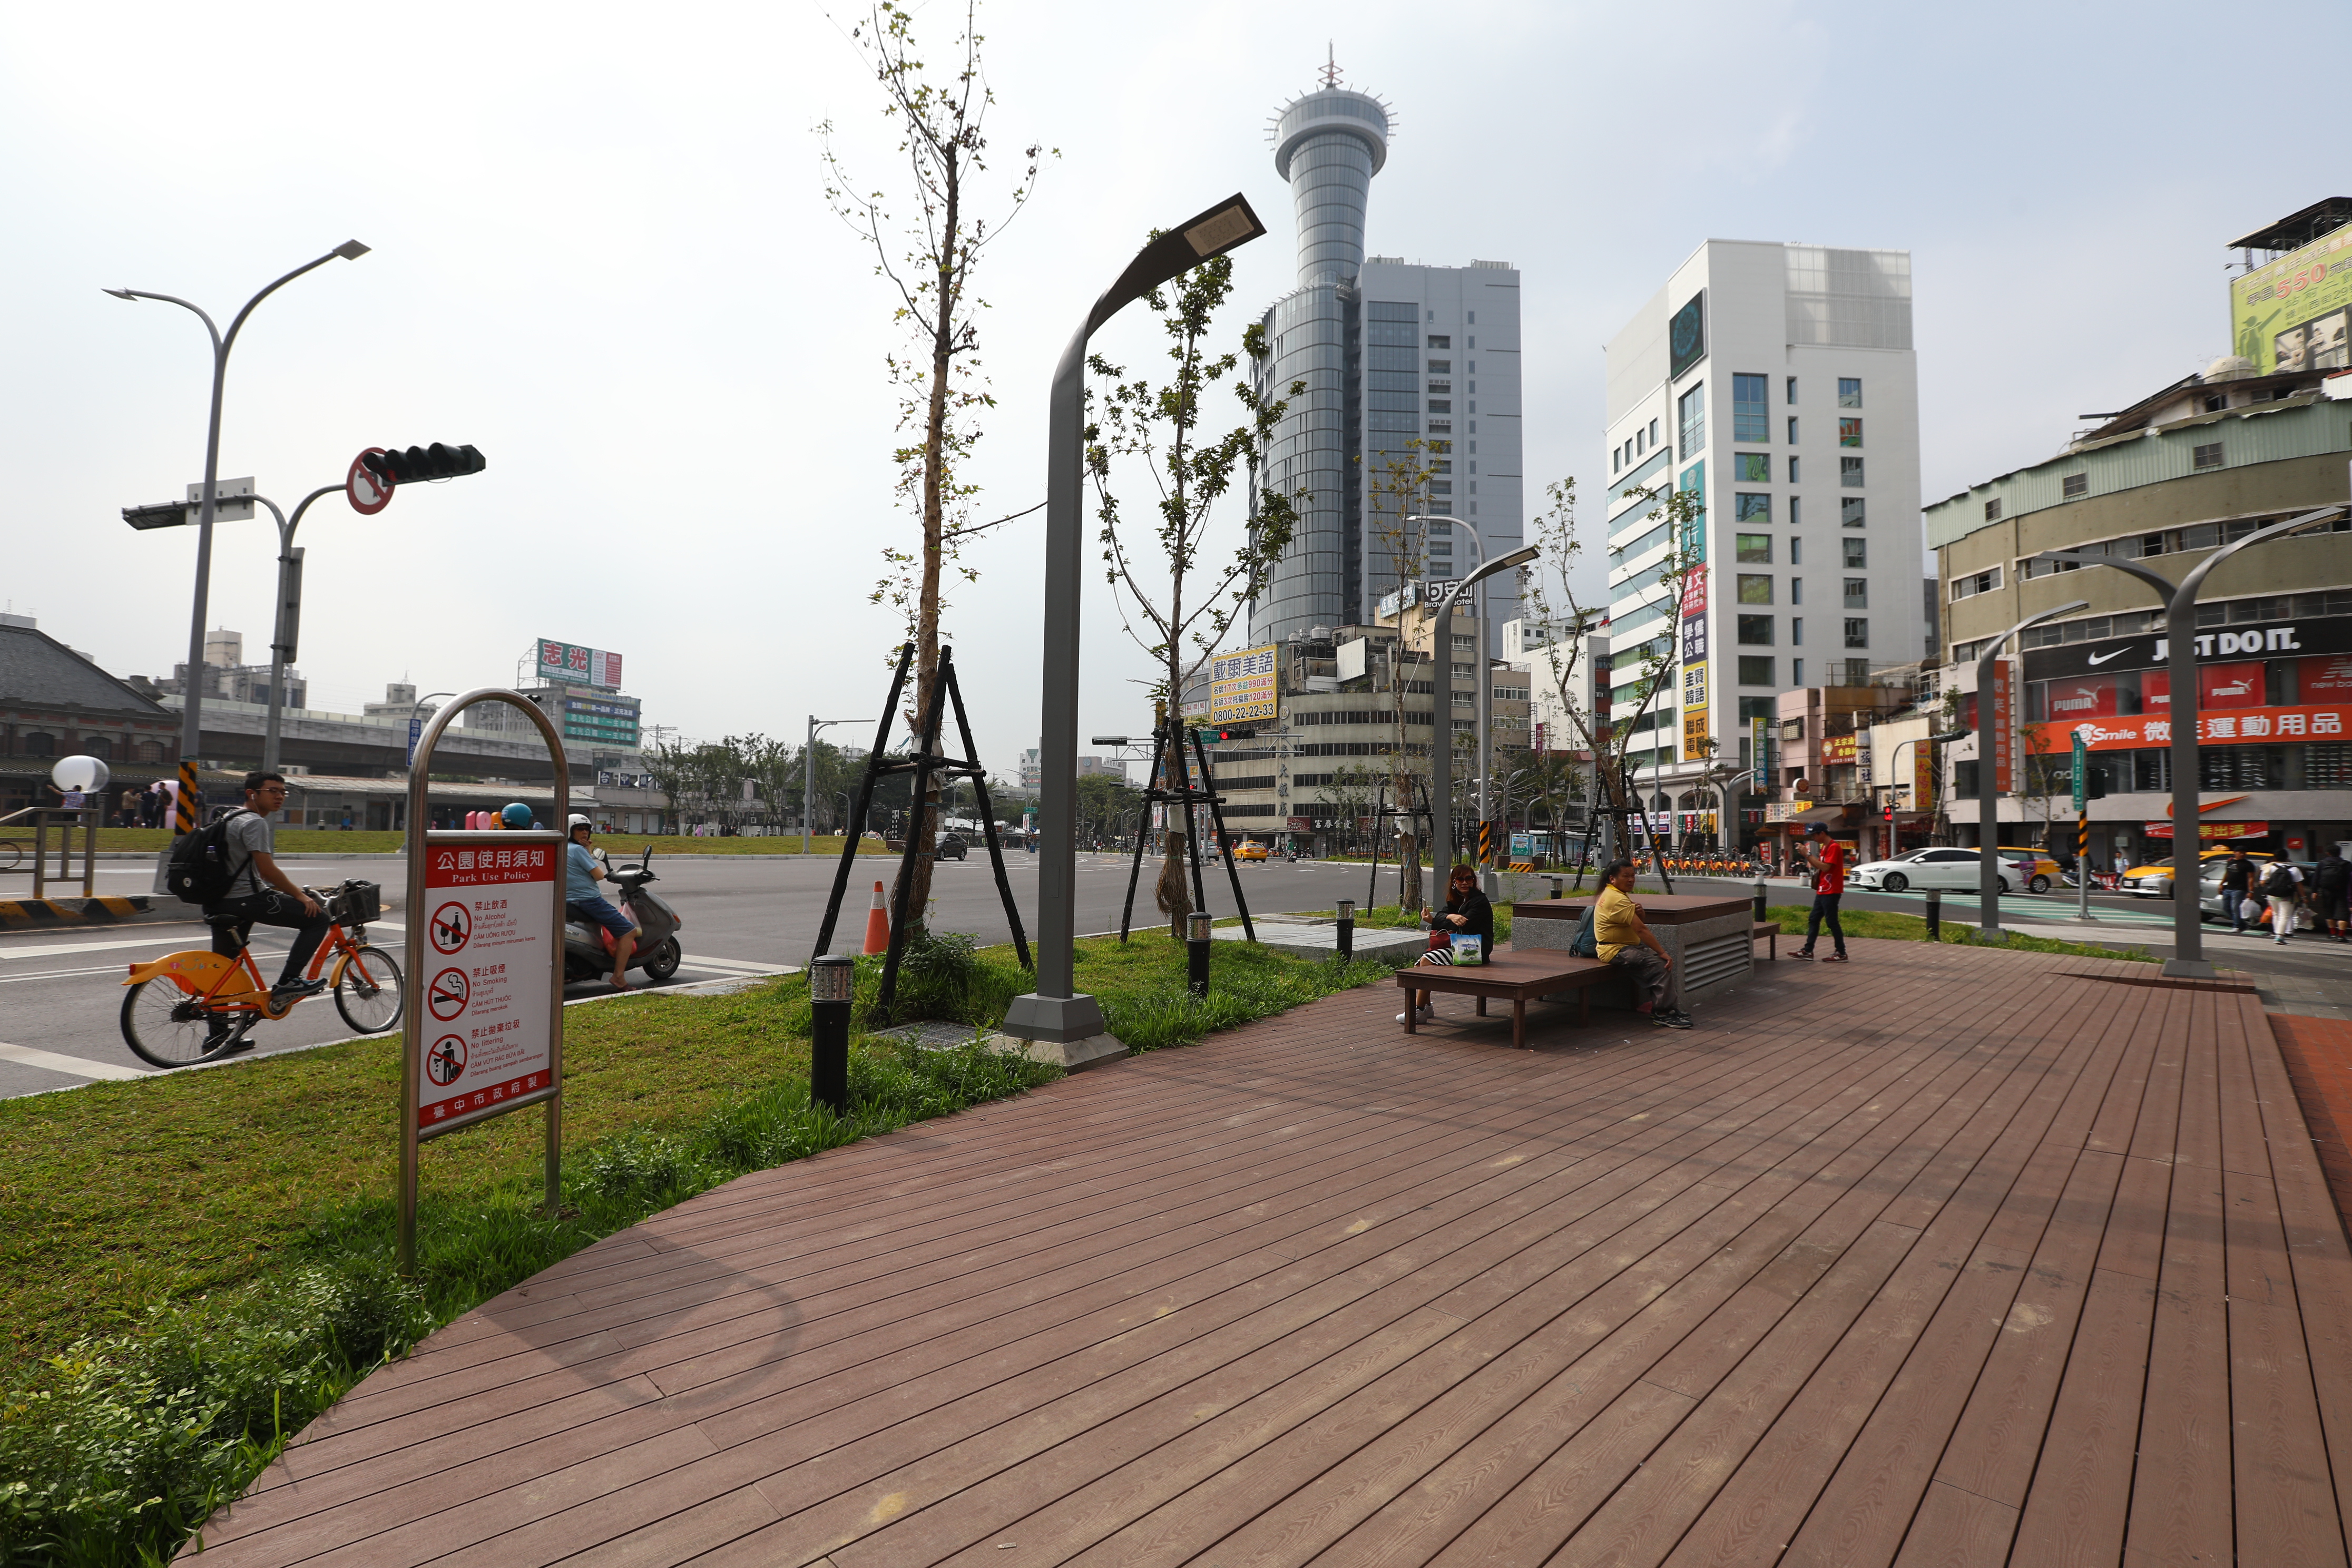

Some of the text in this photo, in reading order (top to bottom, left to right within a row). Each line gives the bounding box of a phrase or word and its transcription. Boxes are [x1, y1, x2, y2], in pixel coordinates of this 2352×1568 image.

[2286, 285, 2352, 320] 綠川西街29
[2219, 630, 2263, 654] DO
[542, 642, 587, 671] 志光
[1213, 651, 1274, 680] 戴爾美語
[1213, 677, 1273, 694] 名師17次多益990滿分
[2212, 687, 2246, 697] PUMA
[1213, 690, 1273, 707] 名師3次托福皆120滿分
[2054, 697, 2092, 711] PUMA
[1213, 703, 1273, 722] 0800-22-22-33
[2092, 728, 2137, 741] Smile
[2143, 712, 2342, 742] 微運動用品
[437, 849, 544, 870] 公園使用須知
[452, 871, 531, 883] Park Use Policy
[474, 899, 507, 912] 禁止飲酒
[473, 964, 506, 978] 禁止吸煙
[483, 977, 507, 986] Smoking
[490, 1004, 508, 1012] merokok
[482, 1037, 503, 1046] littering
[470, 1069, 488, 1077] Dilarang
[519, 1053, 544, 1063] sembarangan
[434, 1075, 537, 1119] 臺中市政府製
